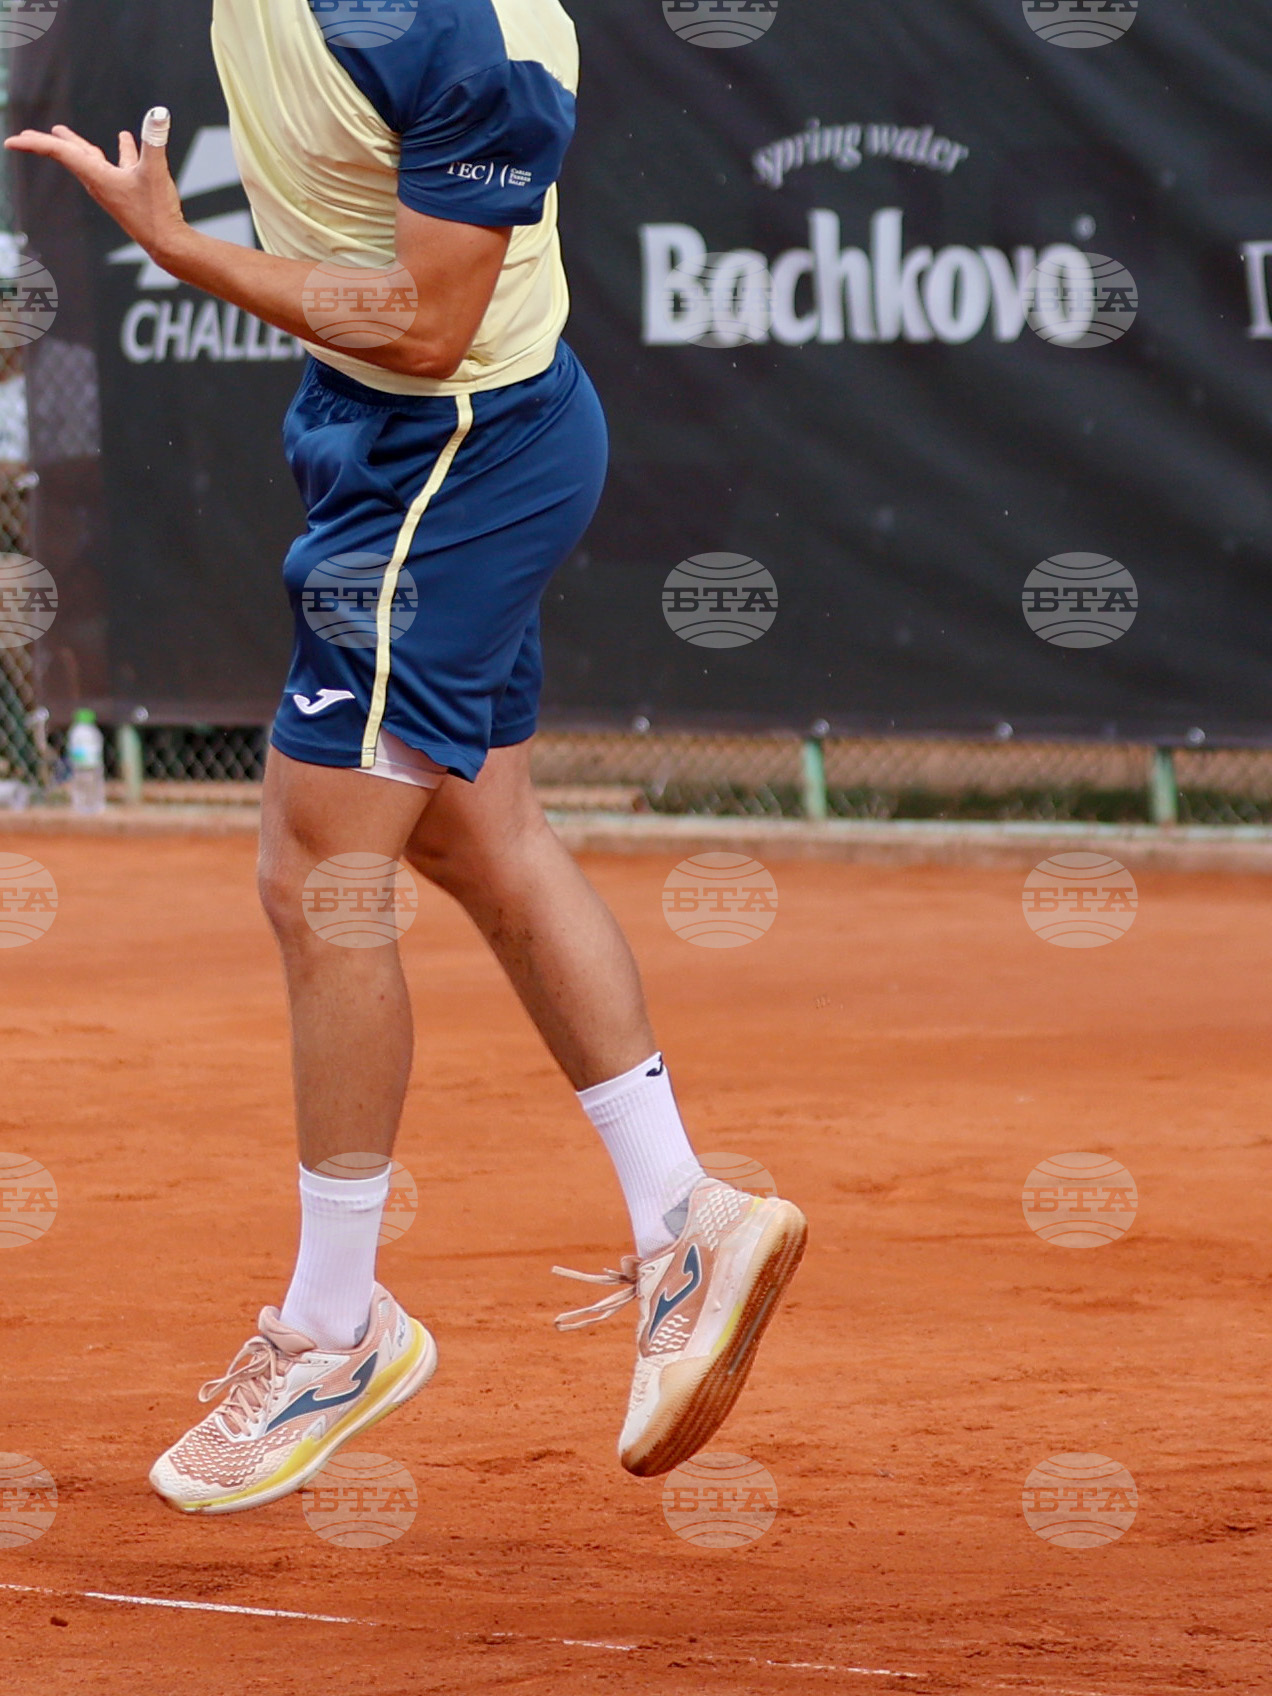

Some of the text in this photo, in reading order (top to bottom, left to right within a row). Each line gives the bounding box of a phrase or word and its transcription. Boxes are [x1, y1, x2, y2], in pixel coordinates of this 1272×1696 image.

[751, 116, 971, 191] spring water
[640, 206, 1094, 346] Bachkovo
[120, 298, 307, 364] CHALLE
